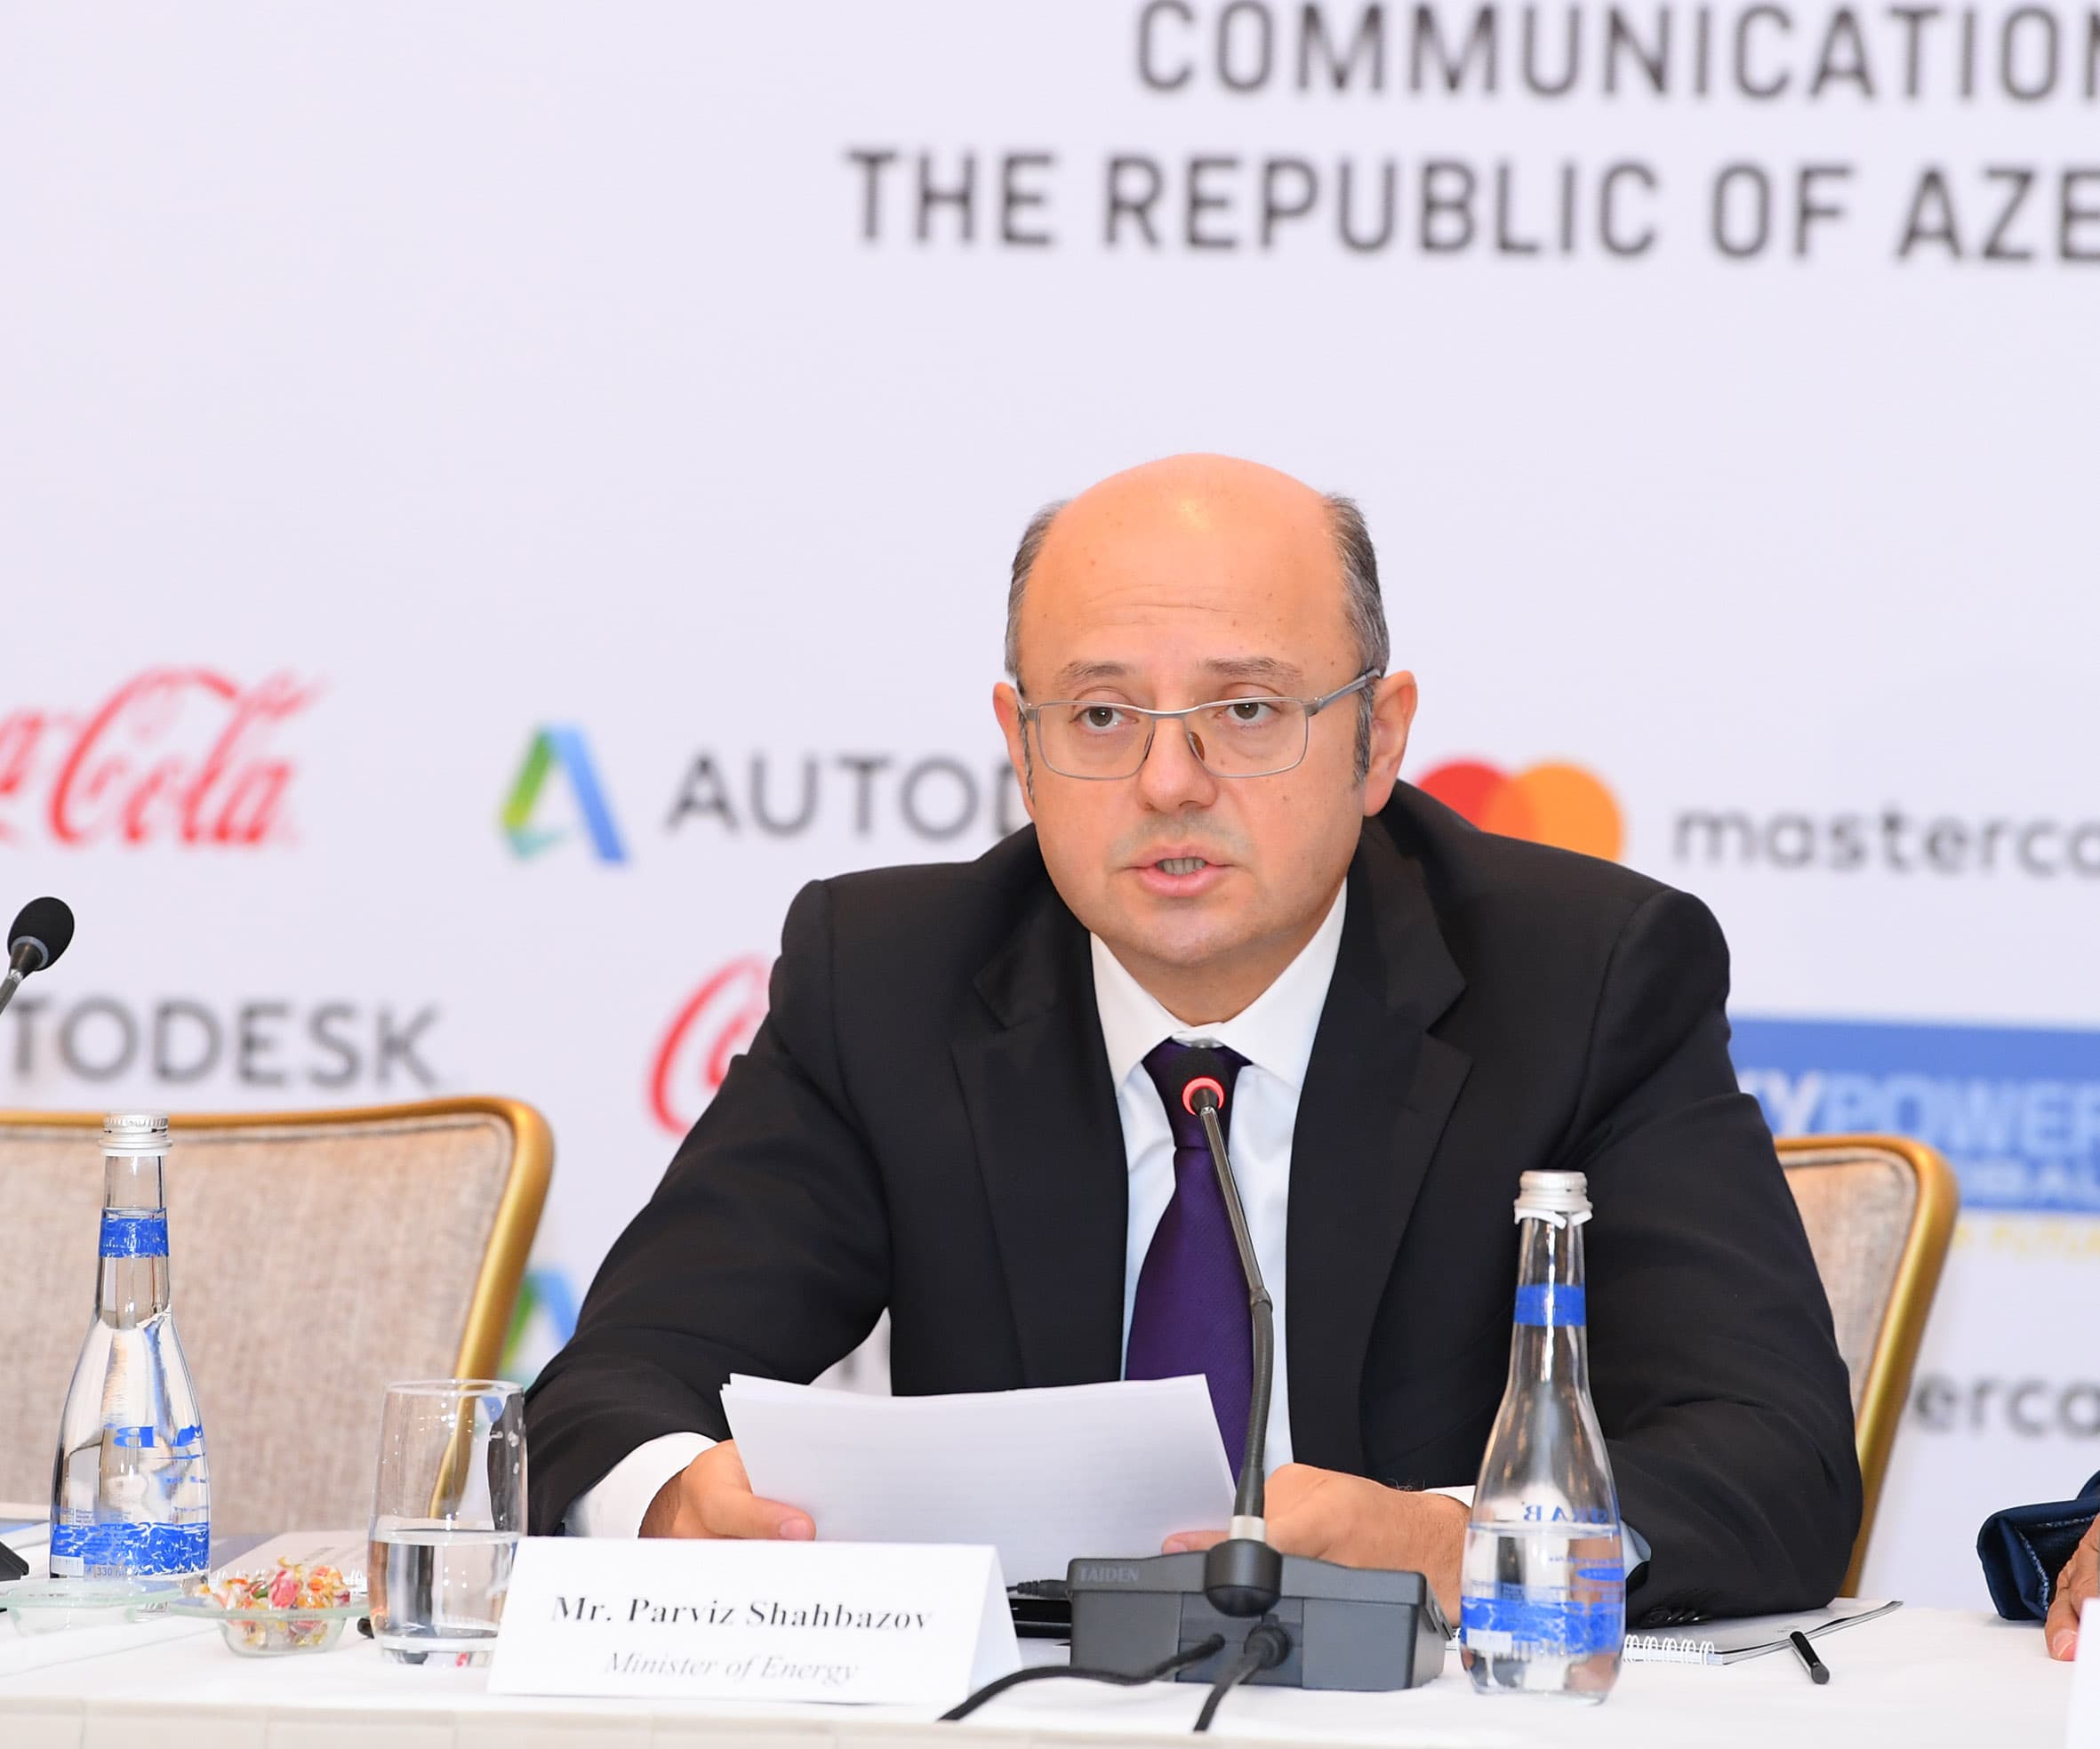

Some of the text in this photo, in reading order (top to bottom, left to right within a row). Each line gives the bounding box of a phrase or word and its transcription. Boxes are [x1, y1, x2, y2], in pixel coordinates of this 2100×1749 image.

[844, 147, 1055, 247] THE
[1102, 153, 1658, 259] REPUBLIC
[1711, 162, 1852, 261] OF
[1080, 1566, 1139, 1581] TAIDEN
[549, 1596, 932, 1630] Mr. Parviz Shahbazov
[605, 1651, 860, 1685] Minister of Energy
